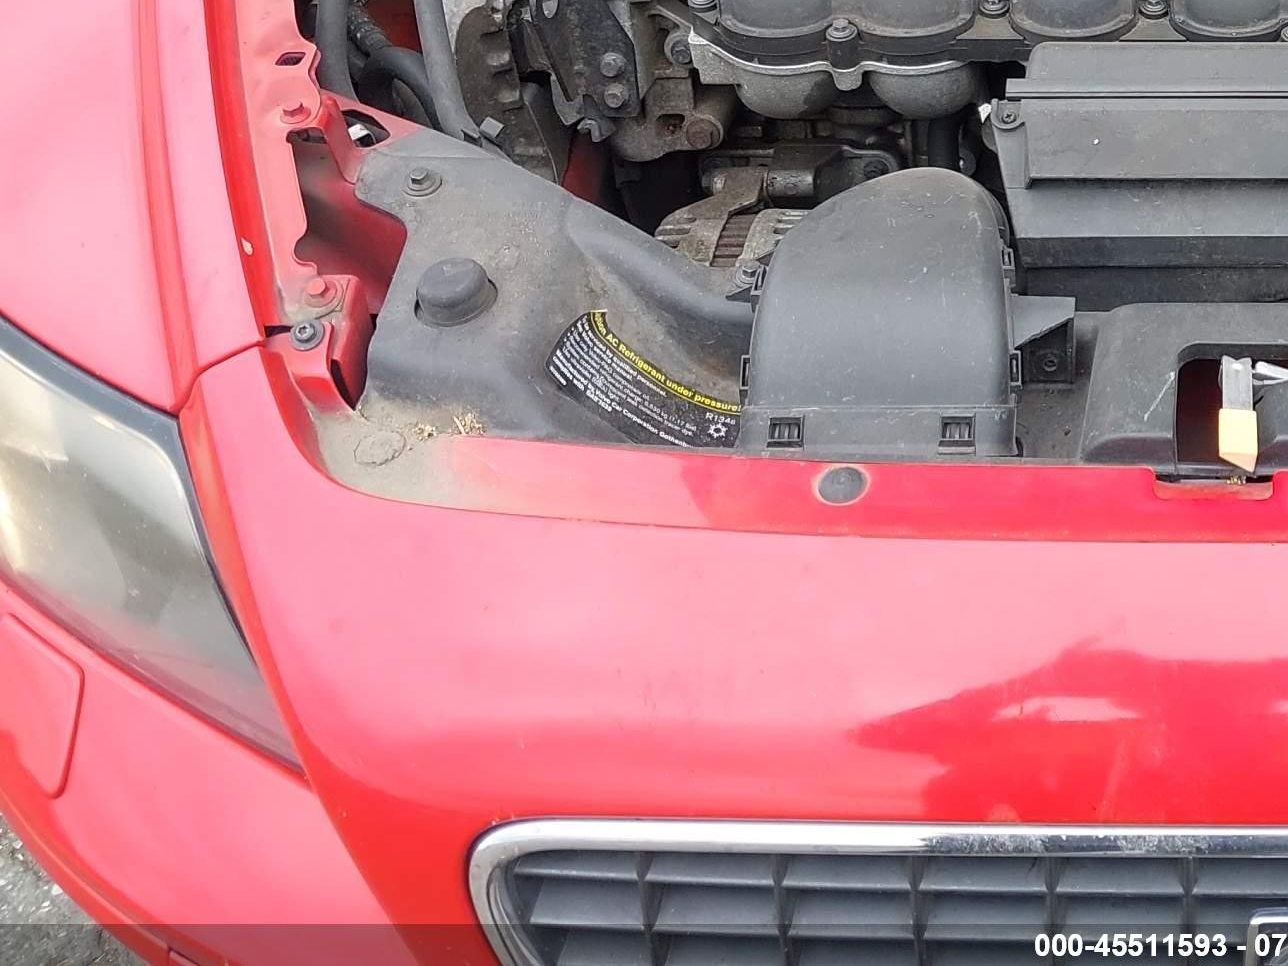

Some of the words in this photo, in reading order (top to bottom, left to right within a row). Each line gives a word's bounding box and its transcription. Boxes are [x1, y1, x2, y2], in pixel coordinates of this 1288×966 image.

[606, 333, 619, 347] AC
[618, 344, 666, 384] Refrigerant
[665, 378, 694, 398] under
[693, 393, 742, 413] pressure!
[622, 408, 659, 435] Corporation
[705, 412, 736, 425] R134a
